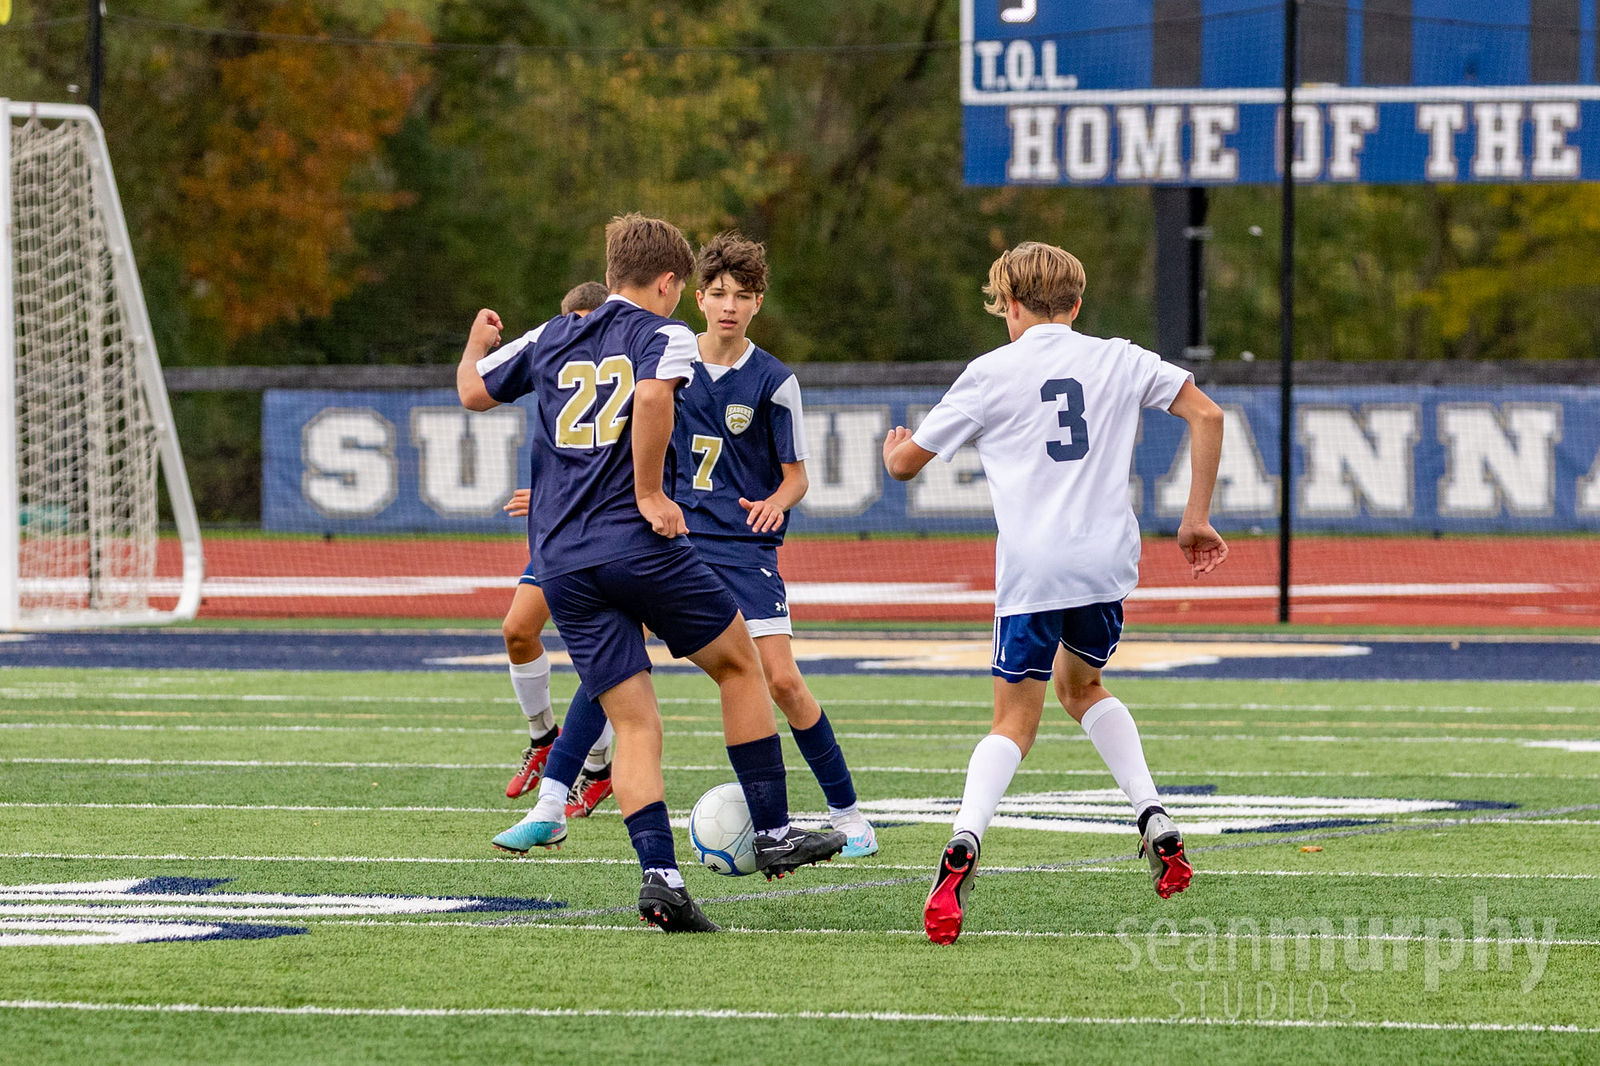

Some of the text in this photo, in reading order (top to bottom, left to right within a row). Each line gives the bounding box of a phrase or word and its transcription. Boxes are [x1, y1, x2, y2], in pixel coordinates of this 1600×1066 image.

[975, 40, 1079, 90] T.O.L.
[1008, 102, 1581, 181] HOME OF THE
[556, 354, 635, 449] 22
[1040, 377, 1089, 462] 3
[691, 434, 723, 492] 7
